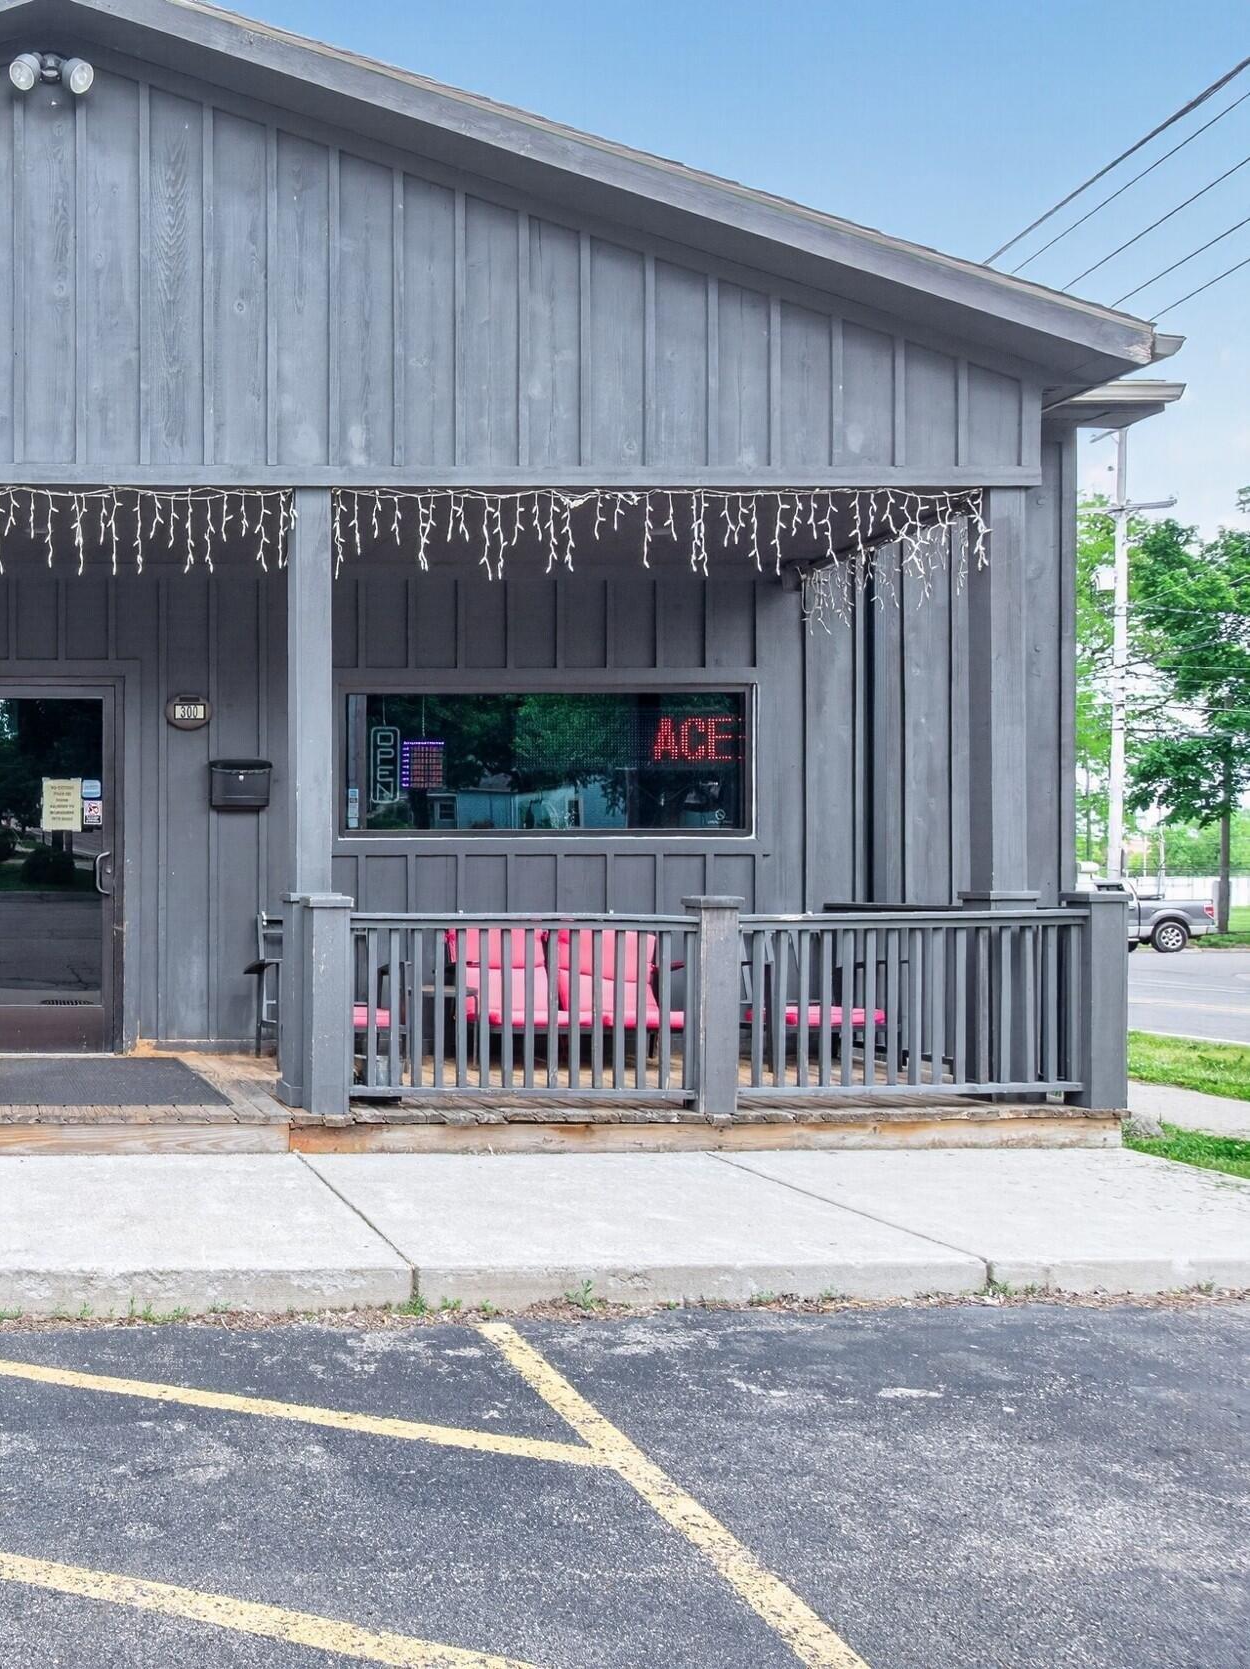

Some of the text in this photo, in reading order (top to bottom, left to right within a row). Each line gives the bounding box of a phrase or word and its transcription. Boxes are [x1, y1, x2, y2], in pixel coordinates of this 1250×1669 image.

[180, 705, 198, 719] 300
[654, 718, 732, 760] ACE
[377, 731, 395, 801] OPEN
